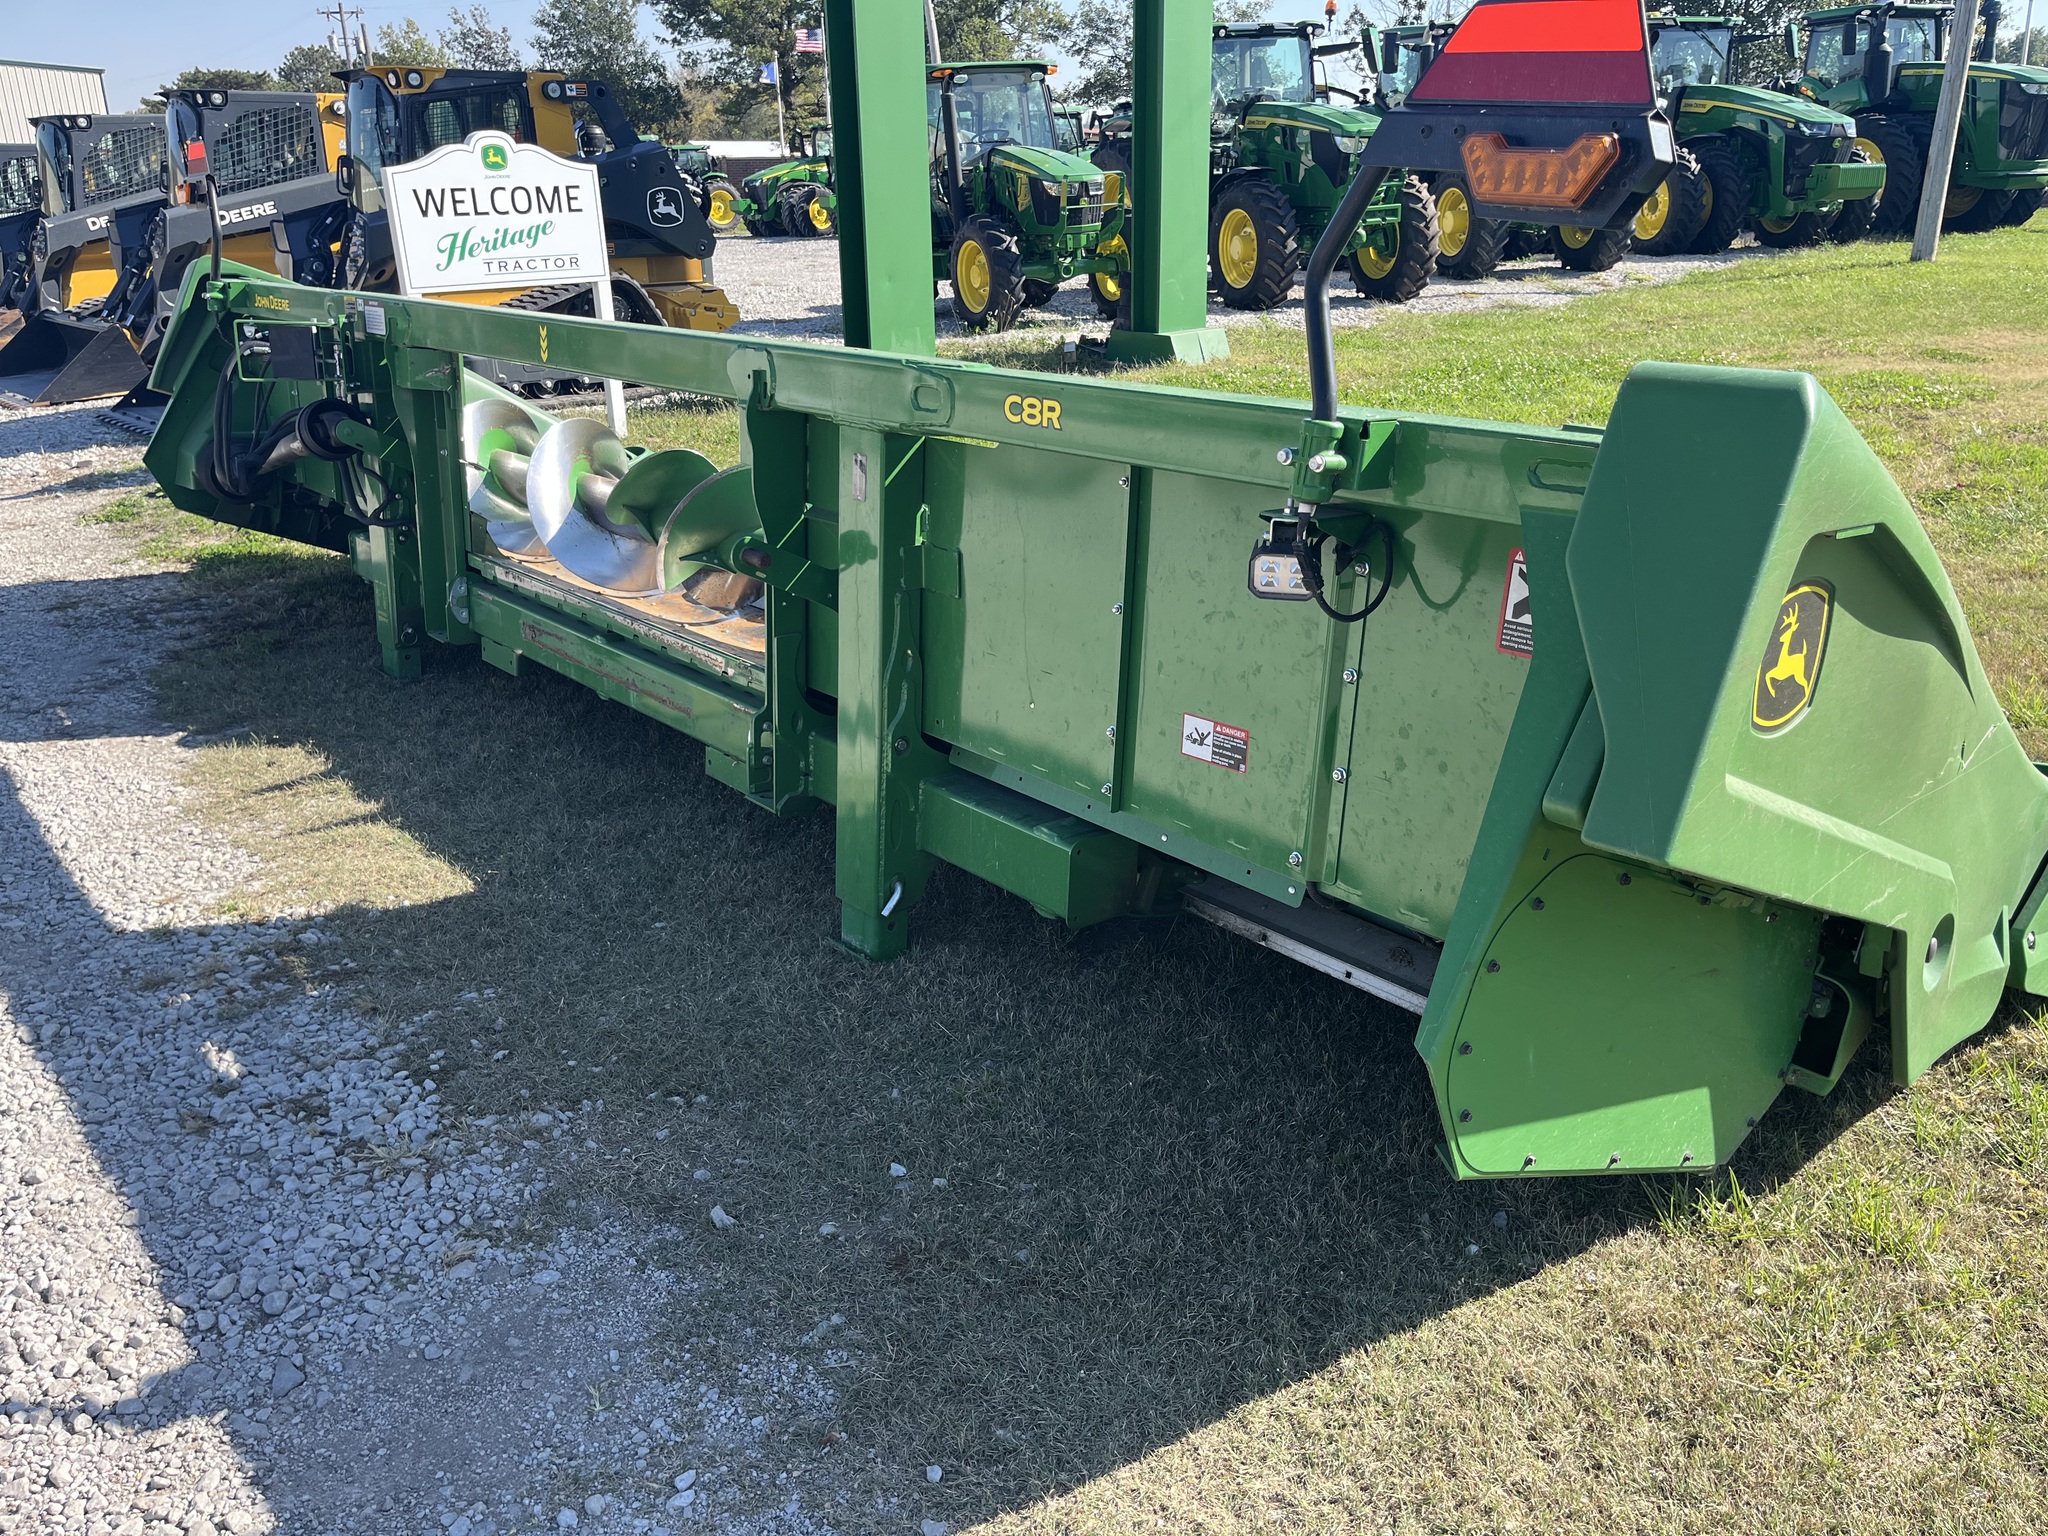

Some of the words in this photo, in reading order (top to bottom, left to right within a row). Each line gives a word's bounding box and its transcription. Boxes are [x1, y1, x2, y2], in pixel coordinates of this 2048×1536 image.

[218, 200, 279, 226] DEERE
[412, 185, 583, 218] WELCOME
[436, 220, 556, 271] Heritage
[483, 256, 580, 273] TRACTOR
[254, 294, 270, 309] JOHN
[269, 295, 290, 311] DEERE
[1004, 394, 1062, 430] C8R
[1222, 727, 1245, 738] DANGER
